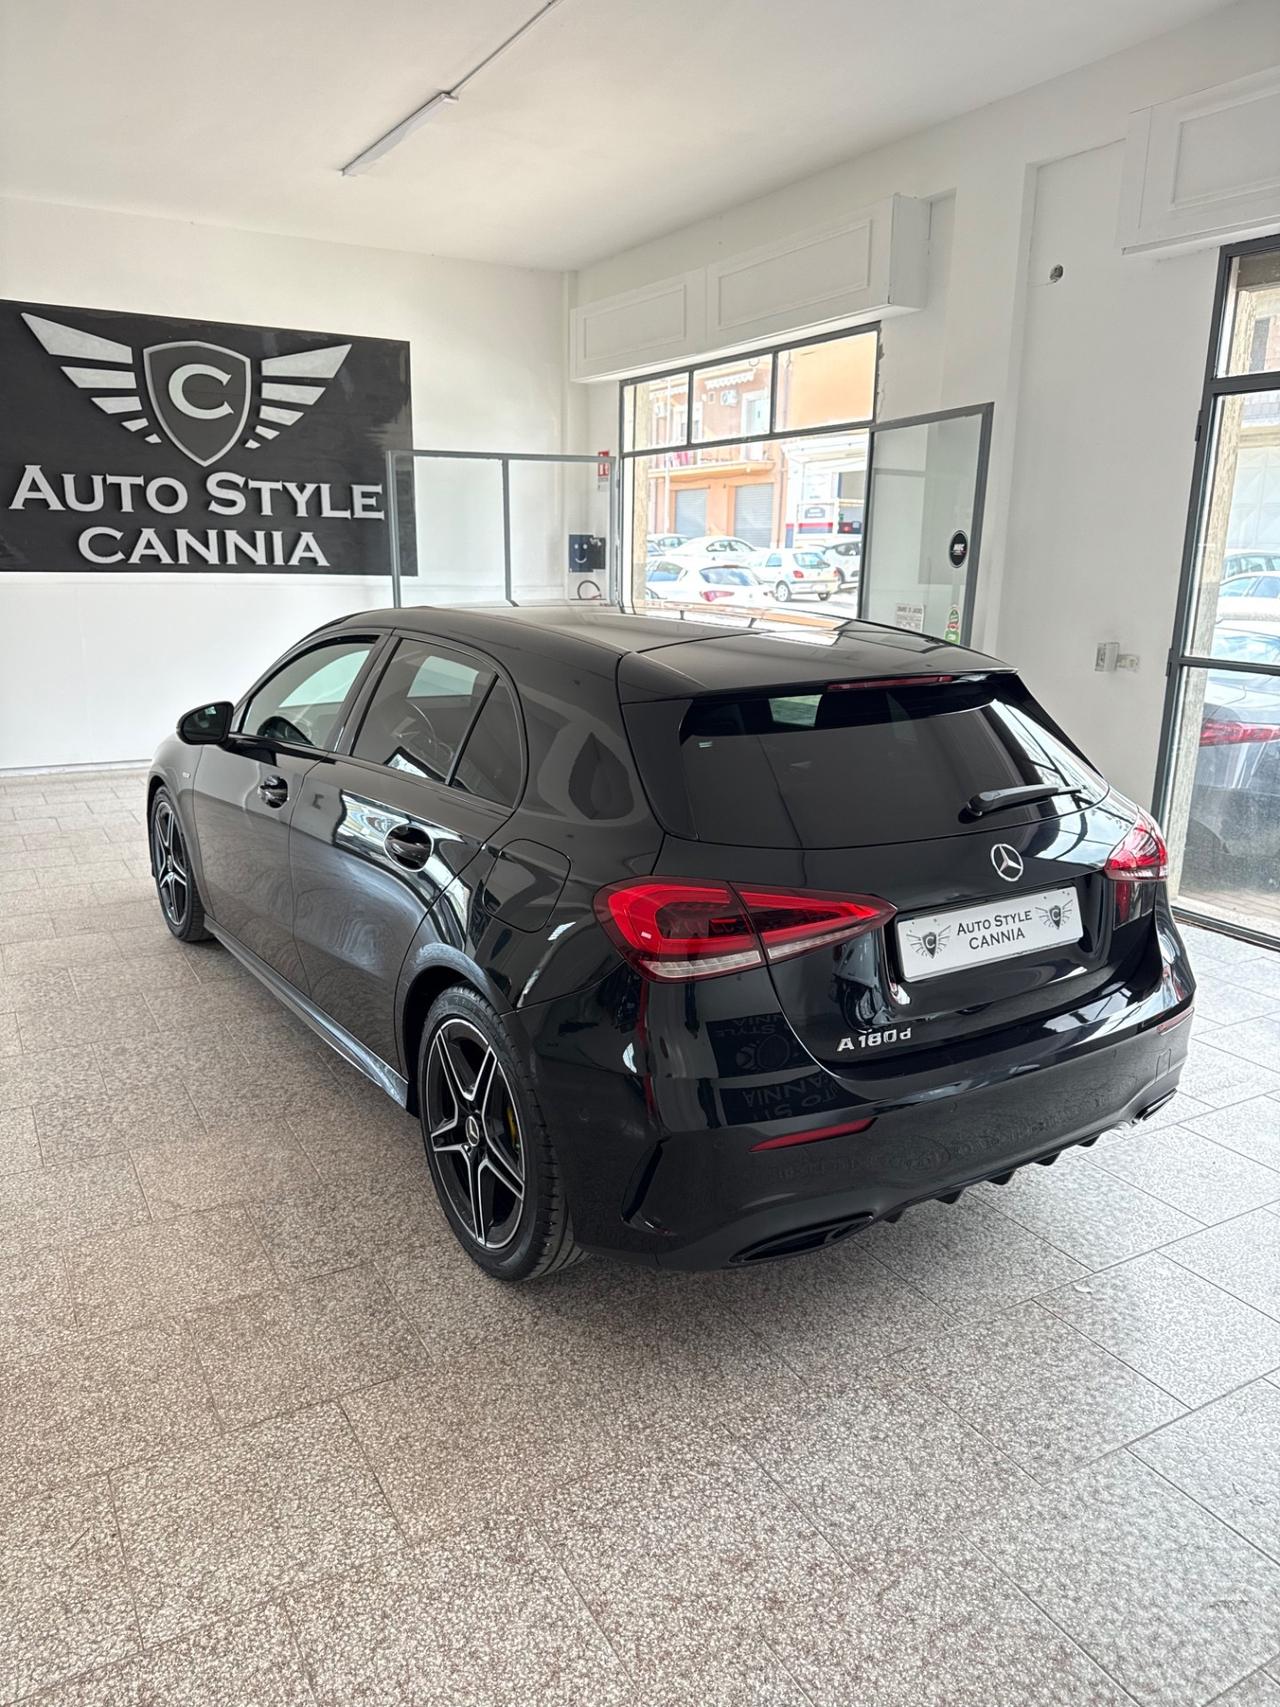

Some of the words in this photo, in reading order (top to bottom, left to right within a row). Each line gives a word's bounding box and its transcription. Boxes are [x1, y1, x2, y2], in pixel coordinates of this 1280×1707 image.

[77, 526, 331, 567] CANNIA
[968, 927, 1026, 950] CANNIA
[836, 1037, 855, 1052] A
